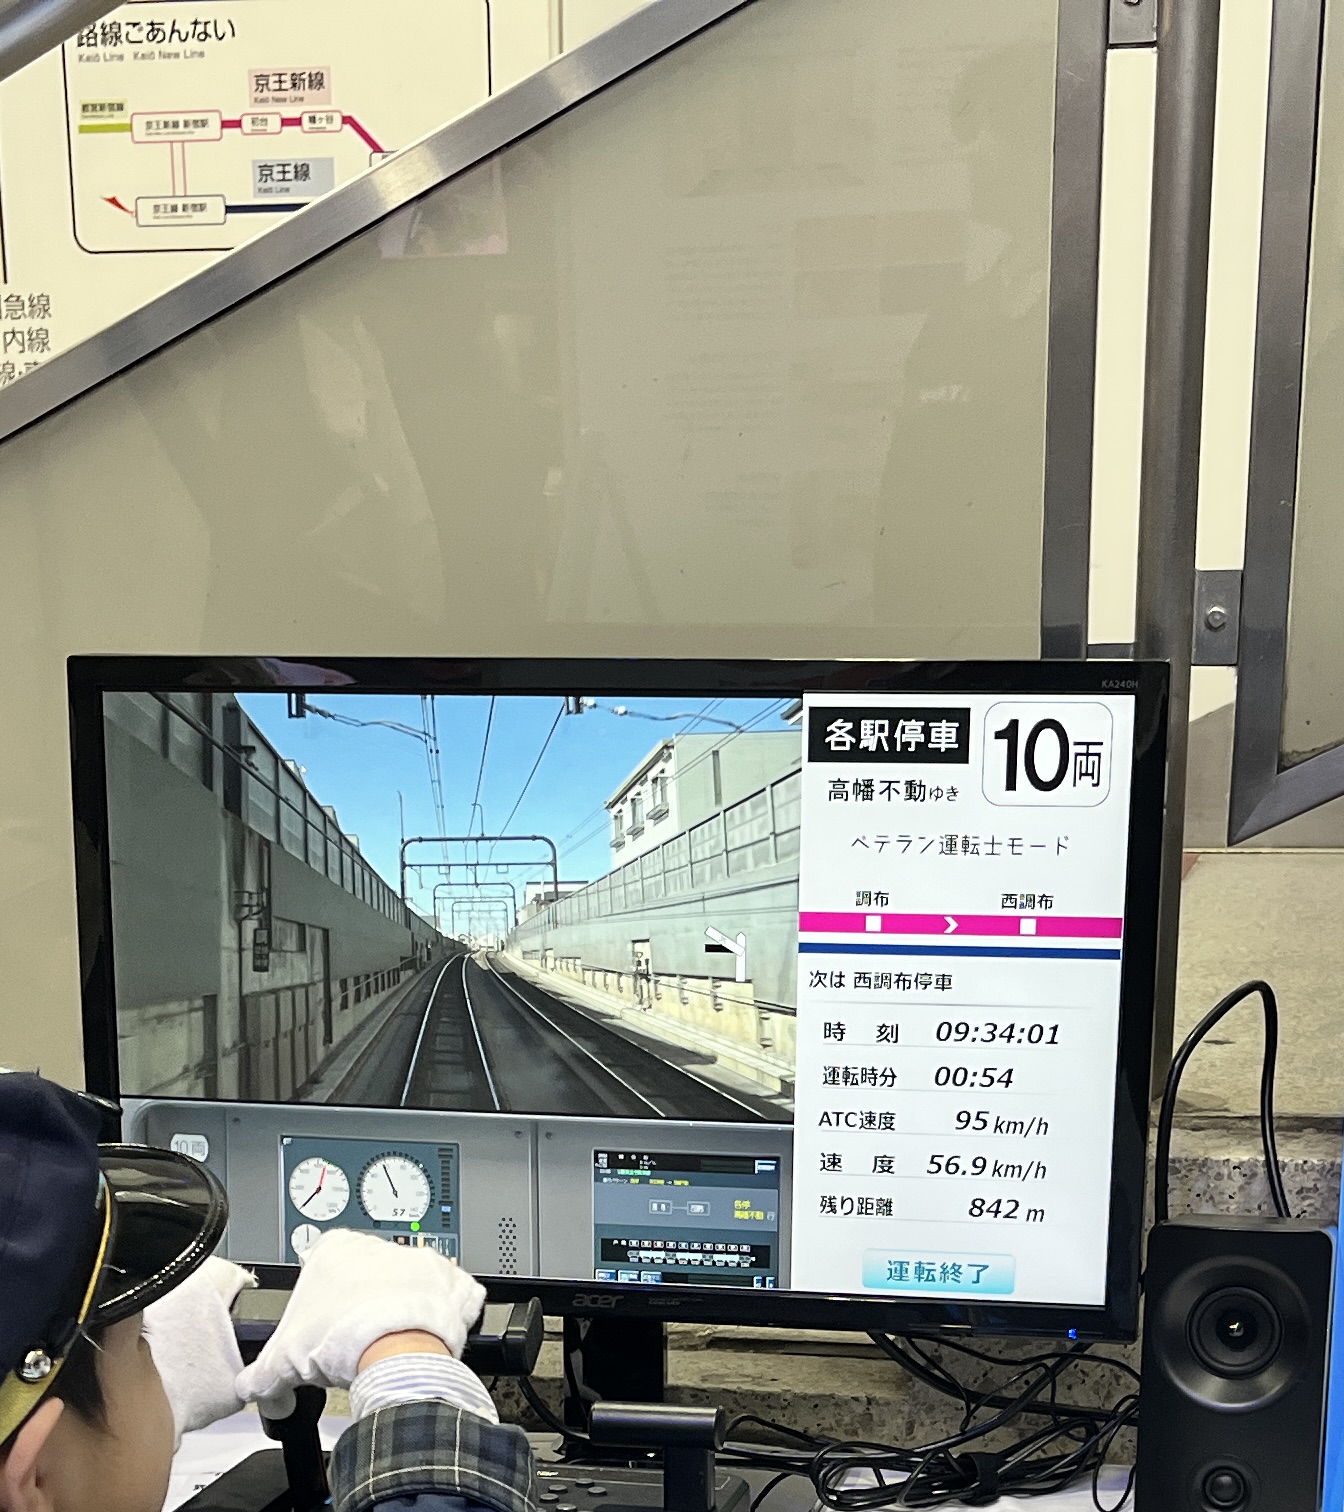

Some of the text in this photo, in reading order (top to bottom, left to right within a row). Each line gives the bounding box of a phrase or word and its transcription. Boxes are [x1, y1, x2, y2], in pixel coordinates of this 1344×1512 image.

[77, 18, 236, 49] 路線ごあんない
[254, 71, 325, 93] 京王新線
[257, 163, 311, 183] 京王線
[824, 719, 960, 753] 各駅停車
[994, 718, 1104, 792] 10両
[827, 778, 960, 803] 高幡不動ゆき
[851, 834, 1070, 857] ベテラン運転士モード
[856, 890, 890, 908] 調布
[1001, 892, 1054, 911] 西調布
[808, 970, 953, 992] 次は 西調布停車
[935, 1021, 1060, 1046] 09:34:01
[822, 1066, 1014, 1089] 運転時分 00:54
[818, 1110, 1049, 1137] ATC速度 95 km/h
[927, 1154, 986, 1176] 56.9
[992, 1158, 1047, 1181] km/h
[819, 1195, 1045, 1221] 残り距離 842 m
[887, 1260, 990, 1285] 運転終了
